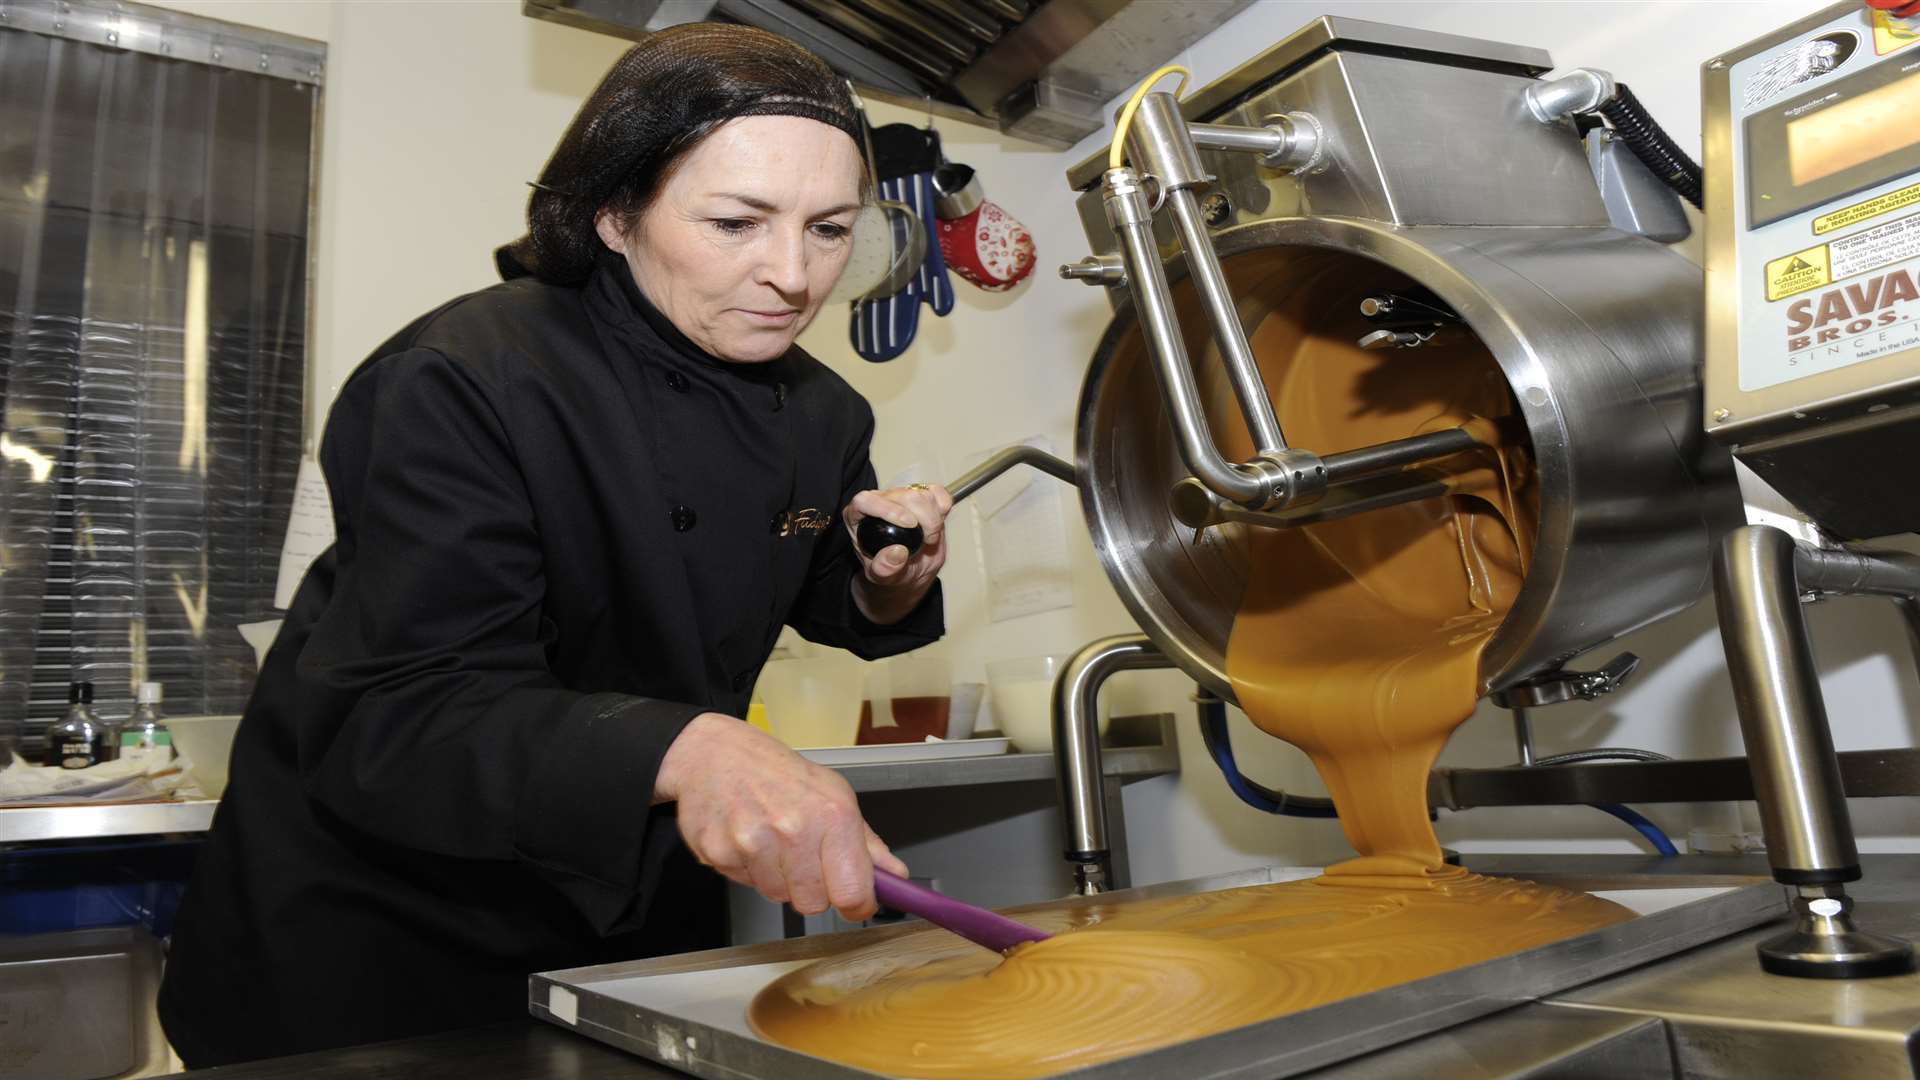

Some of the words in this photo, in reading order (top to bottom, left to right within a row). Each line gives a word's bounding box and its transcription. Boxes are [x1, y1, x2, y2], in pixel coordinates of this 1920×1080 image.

[1826, 210, 1850, 222] KEEP
[1852, 199, 1886, 214] HANDS
[1888, 187, 1920, 201] CLEAR
[1817, 223, 1829, 232] OF
[1831, 208, 1877, 227] ROTATING
[1833, 233, 1870, 248] CONTROL
[1884, 222, 1903, 231] THIS
[1850, 239, 1867, 248] ONE
[1869, 227, 1904, 241] TRAINED
[1774, 266, 1822, 286] CAUTION
[1787, 269, 1920, 336] SAVA
[1788, 310, 1909, 352] BROS.
[1789, 332, 1886, 366] SINCE
[1856, 348, 1878, 358] Made
[1887, 341, 1901, 350] the
